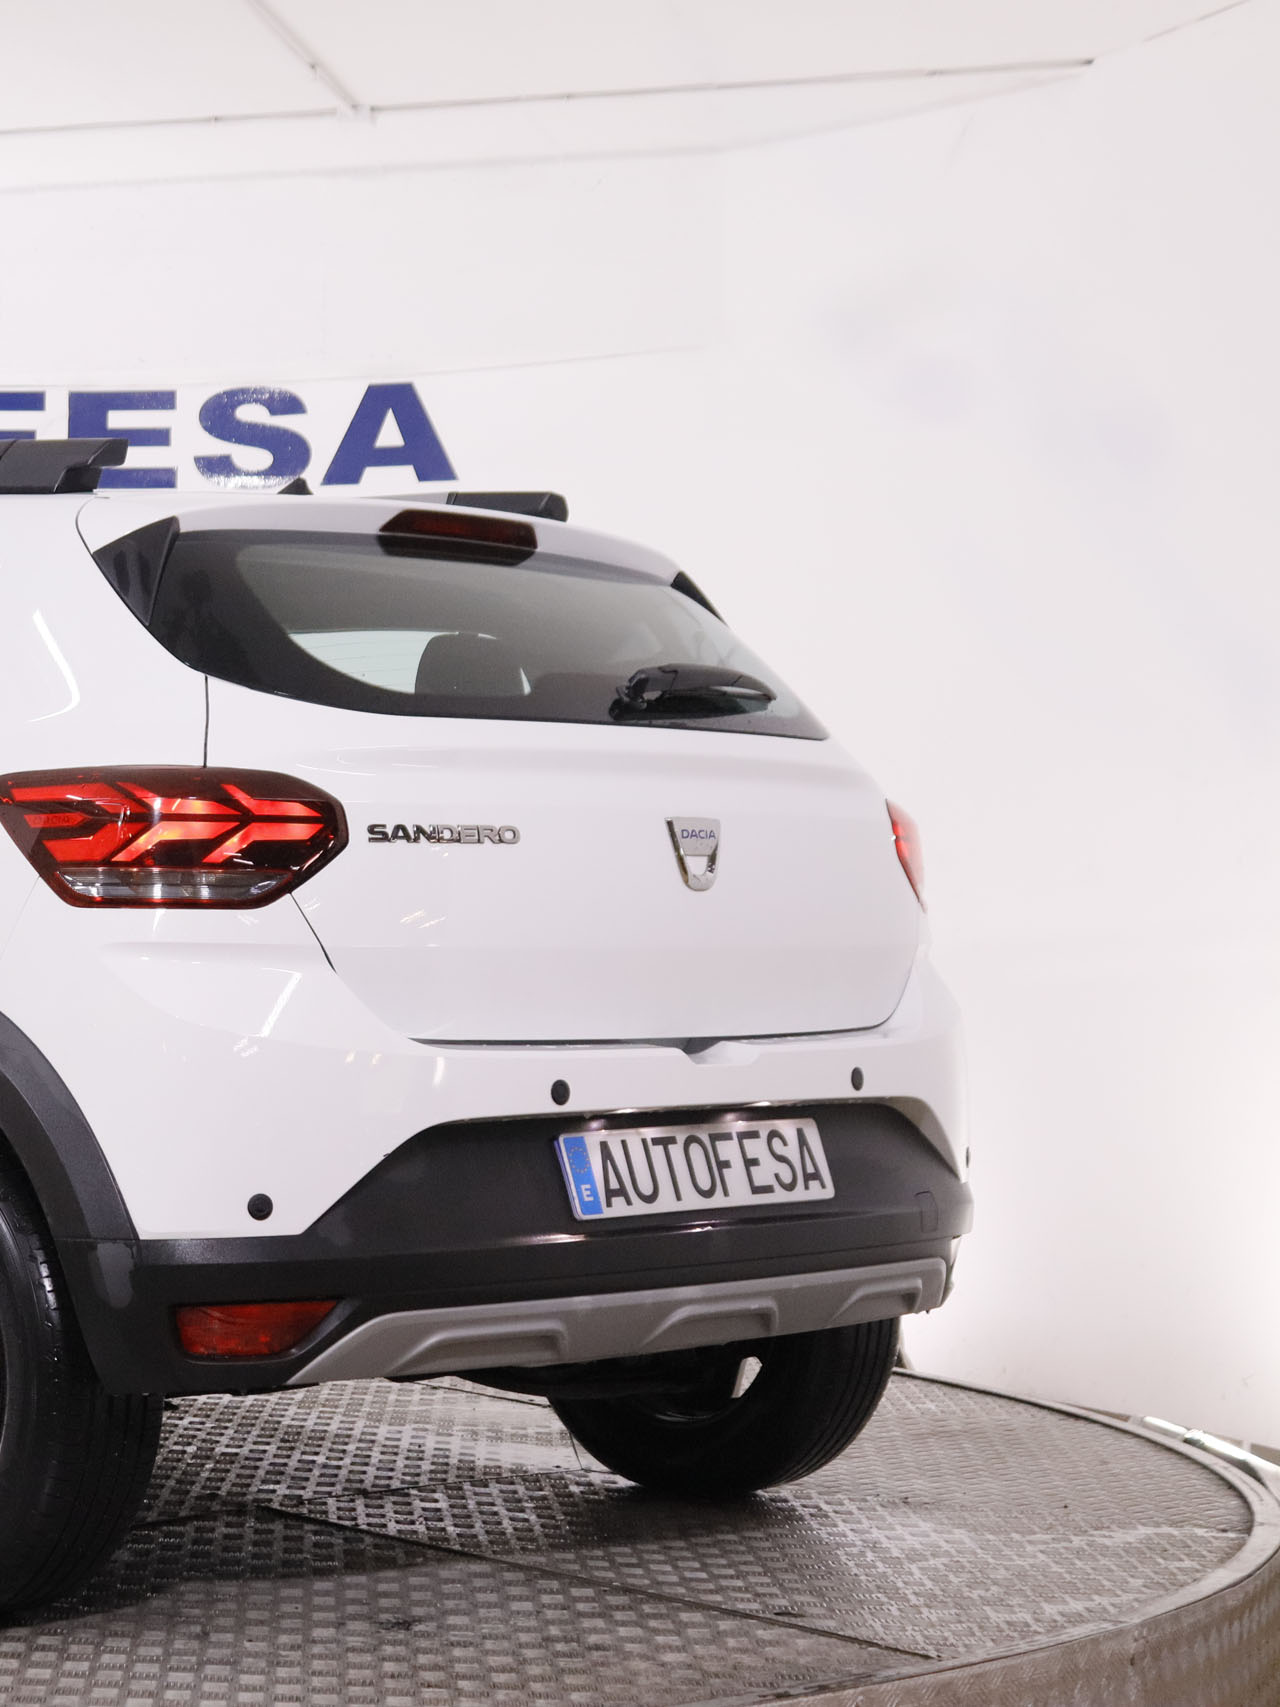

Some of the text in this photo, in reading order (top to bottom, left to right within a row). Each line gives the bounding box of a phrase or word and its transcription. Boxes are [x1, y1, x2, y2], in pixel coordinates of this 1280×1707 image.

[367, 823, 521, 844] SANDERO
[680, 828, 717, 840] DACIA
[599, 1127, 827, 1208] AUTOFESA
[580, 1183, 594, 1202] E
